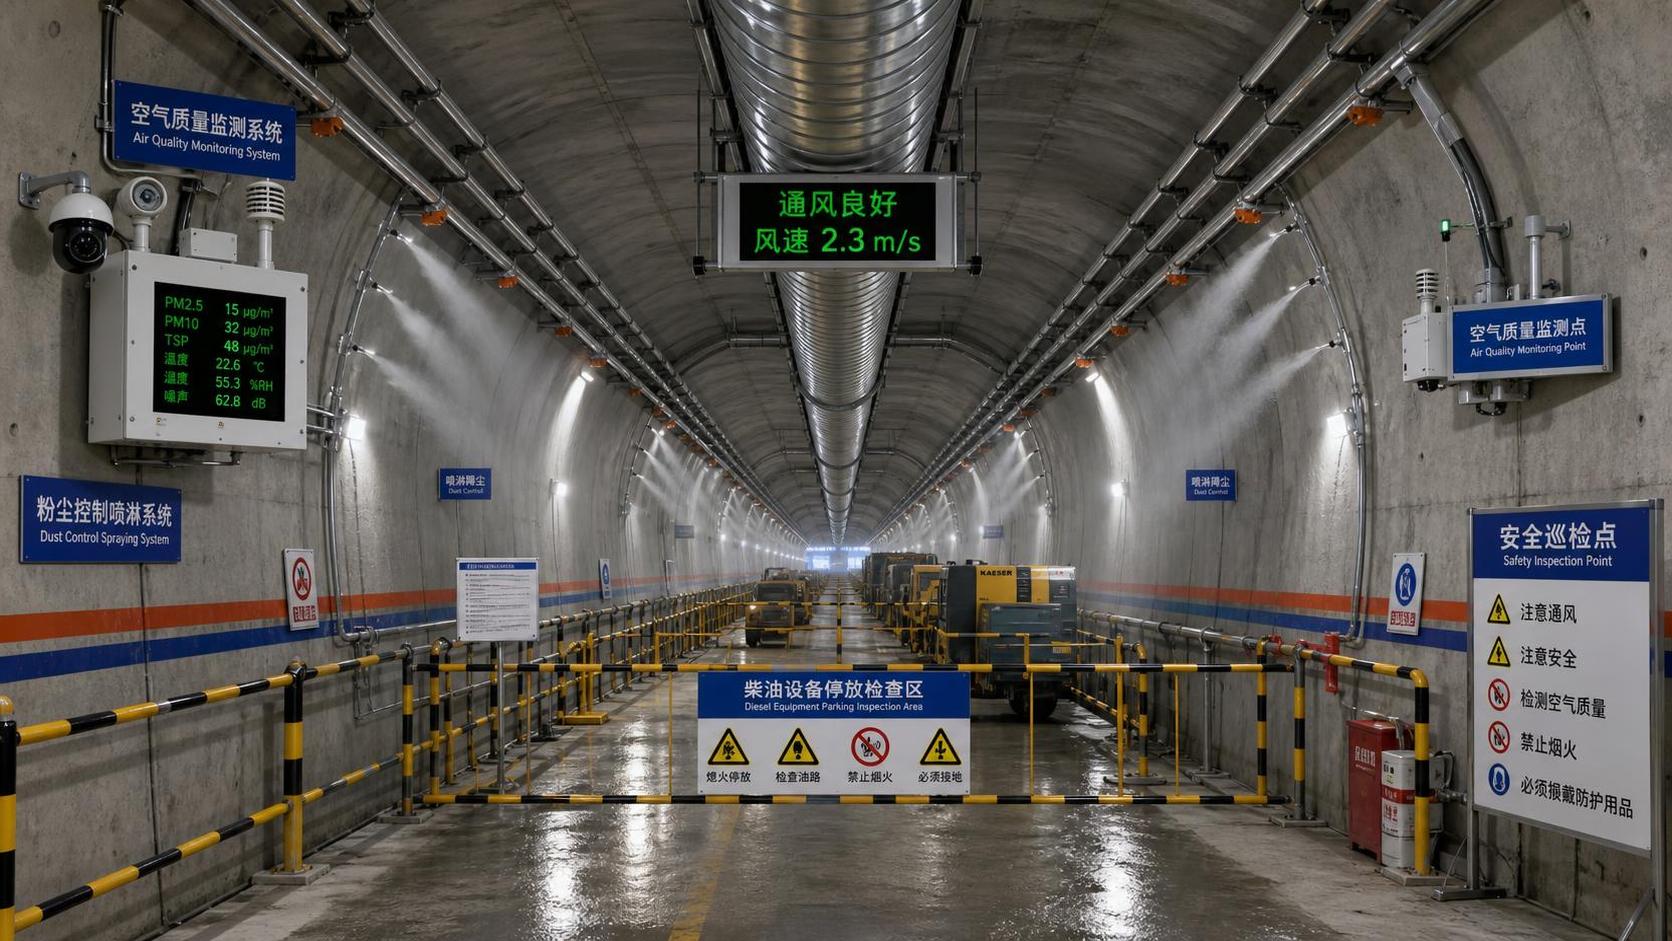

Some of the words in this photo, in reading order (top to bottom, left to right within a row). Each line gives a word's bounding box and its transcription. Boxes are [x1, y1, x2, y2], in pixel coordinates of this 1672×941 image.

[131, 101, 283, 144] 空气质量监测系统
[133, 132, 149, 144] Air
[152, 134, 189, 151] Quality
[191, 141, 244, 158] Monitoring
[246, 147, 281, 161] System
[779, 190, 897, 218] 通风良好
[754, 227, 809, 254] 风速
[821, 227, 865, 253] 2.3
[873, 229, 921, 254] m/s
[165, 296, 204, 312] PM2.5
[225, 303, 239, 316] 15
[165, 315, 199, 330] PM10
[224, 321, 239, 334] 32
[1469, 317, 1587, 343] 空气质量监测点
[164, 333, 189, 347] TSP
[224, 340, 239, 352] 48
[1470, 347, 1483, 358] Air
[1485, 346, 1515, 358] Quality
[1517, 343, 1562, 355] Monitoring
[1564, 342, 1586, 352] Point
[215, 357, 240, 370] 22.6
[215, 376, 240, 389] 55.3
[249, 379, 273, 392] %RH
[215, 395, 240, 407] 62.8
[251, 398, 266, 409] dB
[37, 495, 172, 527] 粉尘控制喷淋系统
[40, 529, 62, 543] Dust
[65, 531, 99, 543] Control
[101, 532, 138, 547] Spraying
[140, 533, 170, 547] System
[1500, 521, 1617, 550] 安全巡检点
[1503, 555, 1532, 569] Safety
[1534, 555, 1583, 568] Inspection
[1586, 554, 1613, 567] Point
[1520, 603, 1577, 624] 注意通风
[1520, 646, 1577, 669] 注意安全
[744, 679, 923, 699] 柴油设备停放检查区
[745, 702, 771, 711] Diesel
[822, 702, 854, 712] Parking
[857, 702, 901, 712] Inspection
[903, 702, 923, 711] Area
[1520, 689, 1607, 719] 检测空气质量
[1520, 732, 1577, 760] 禁止烟火
[776, 771, 820, 783] 检查油路
[848, 771, 893, 783] 禁止烟火
